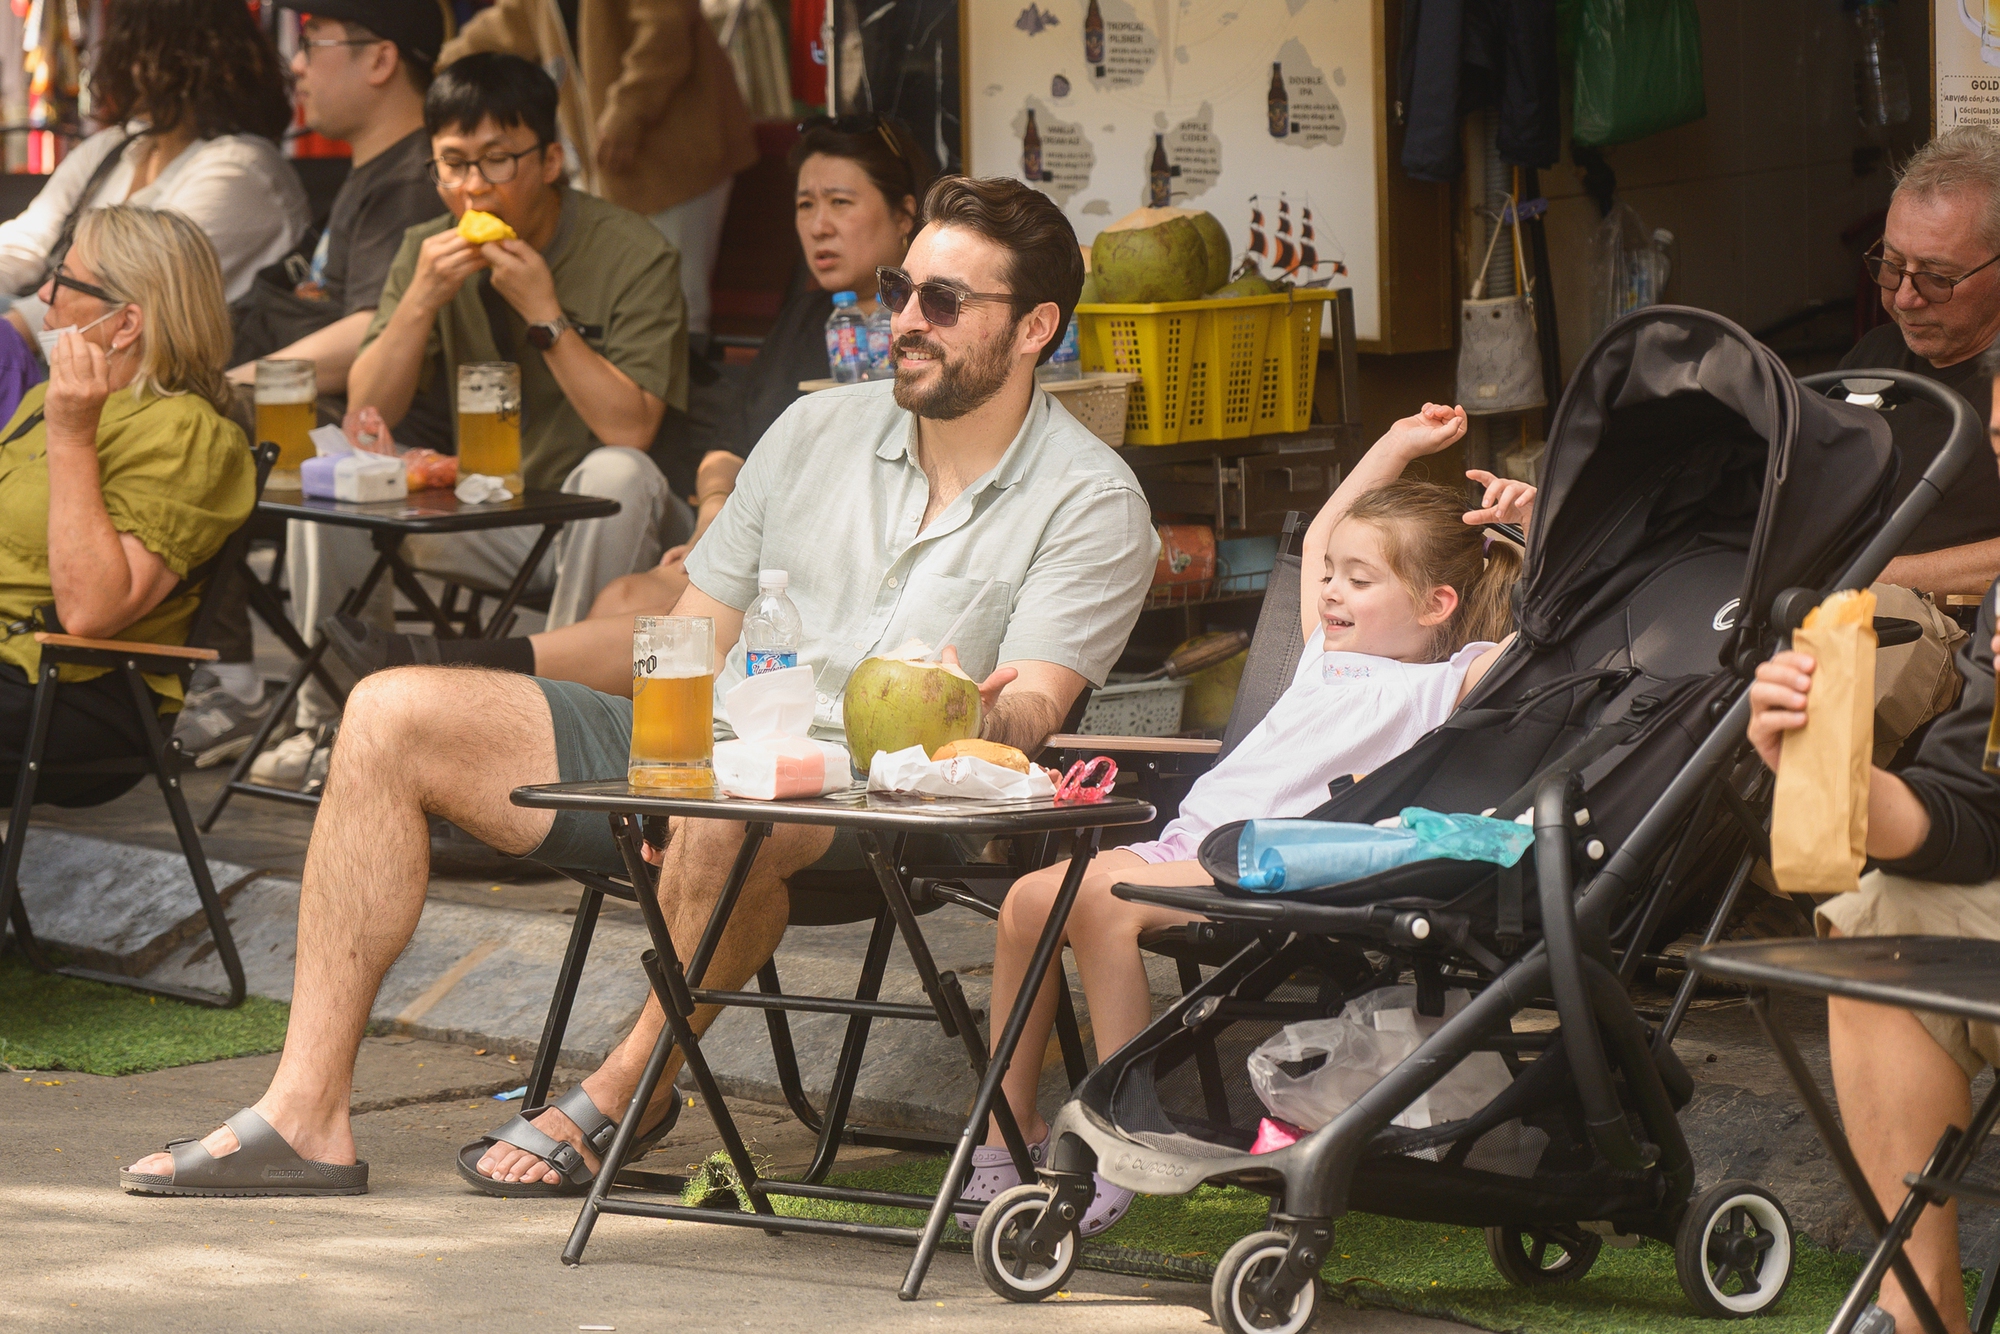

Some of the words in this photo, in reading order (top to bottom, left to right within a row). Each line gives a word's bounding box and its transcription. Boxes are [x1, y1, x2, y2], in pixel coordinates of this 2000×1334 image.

[1289, 76, 1323, 85] DOUBLE
[1971, 80, 1999, 90] GOLD
[1300, 88, 1314, 96] IPA
[1181, 122, 1207, 130] APPLE
